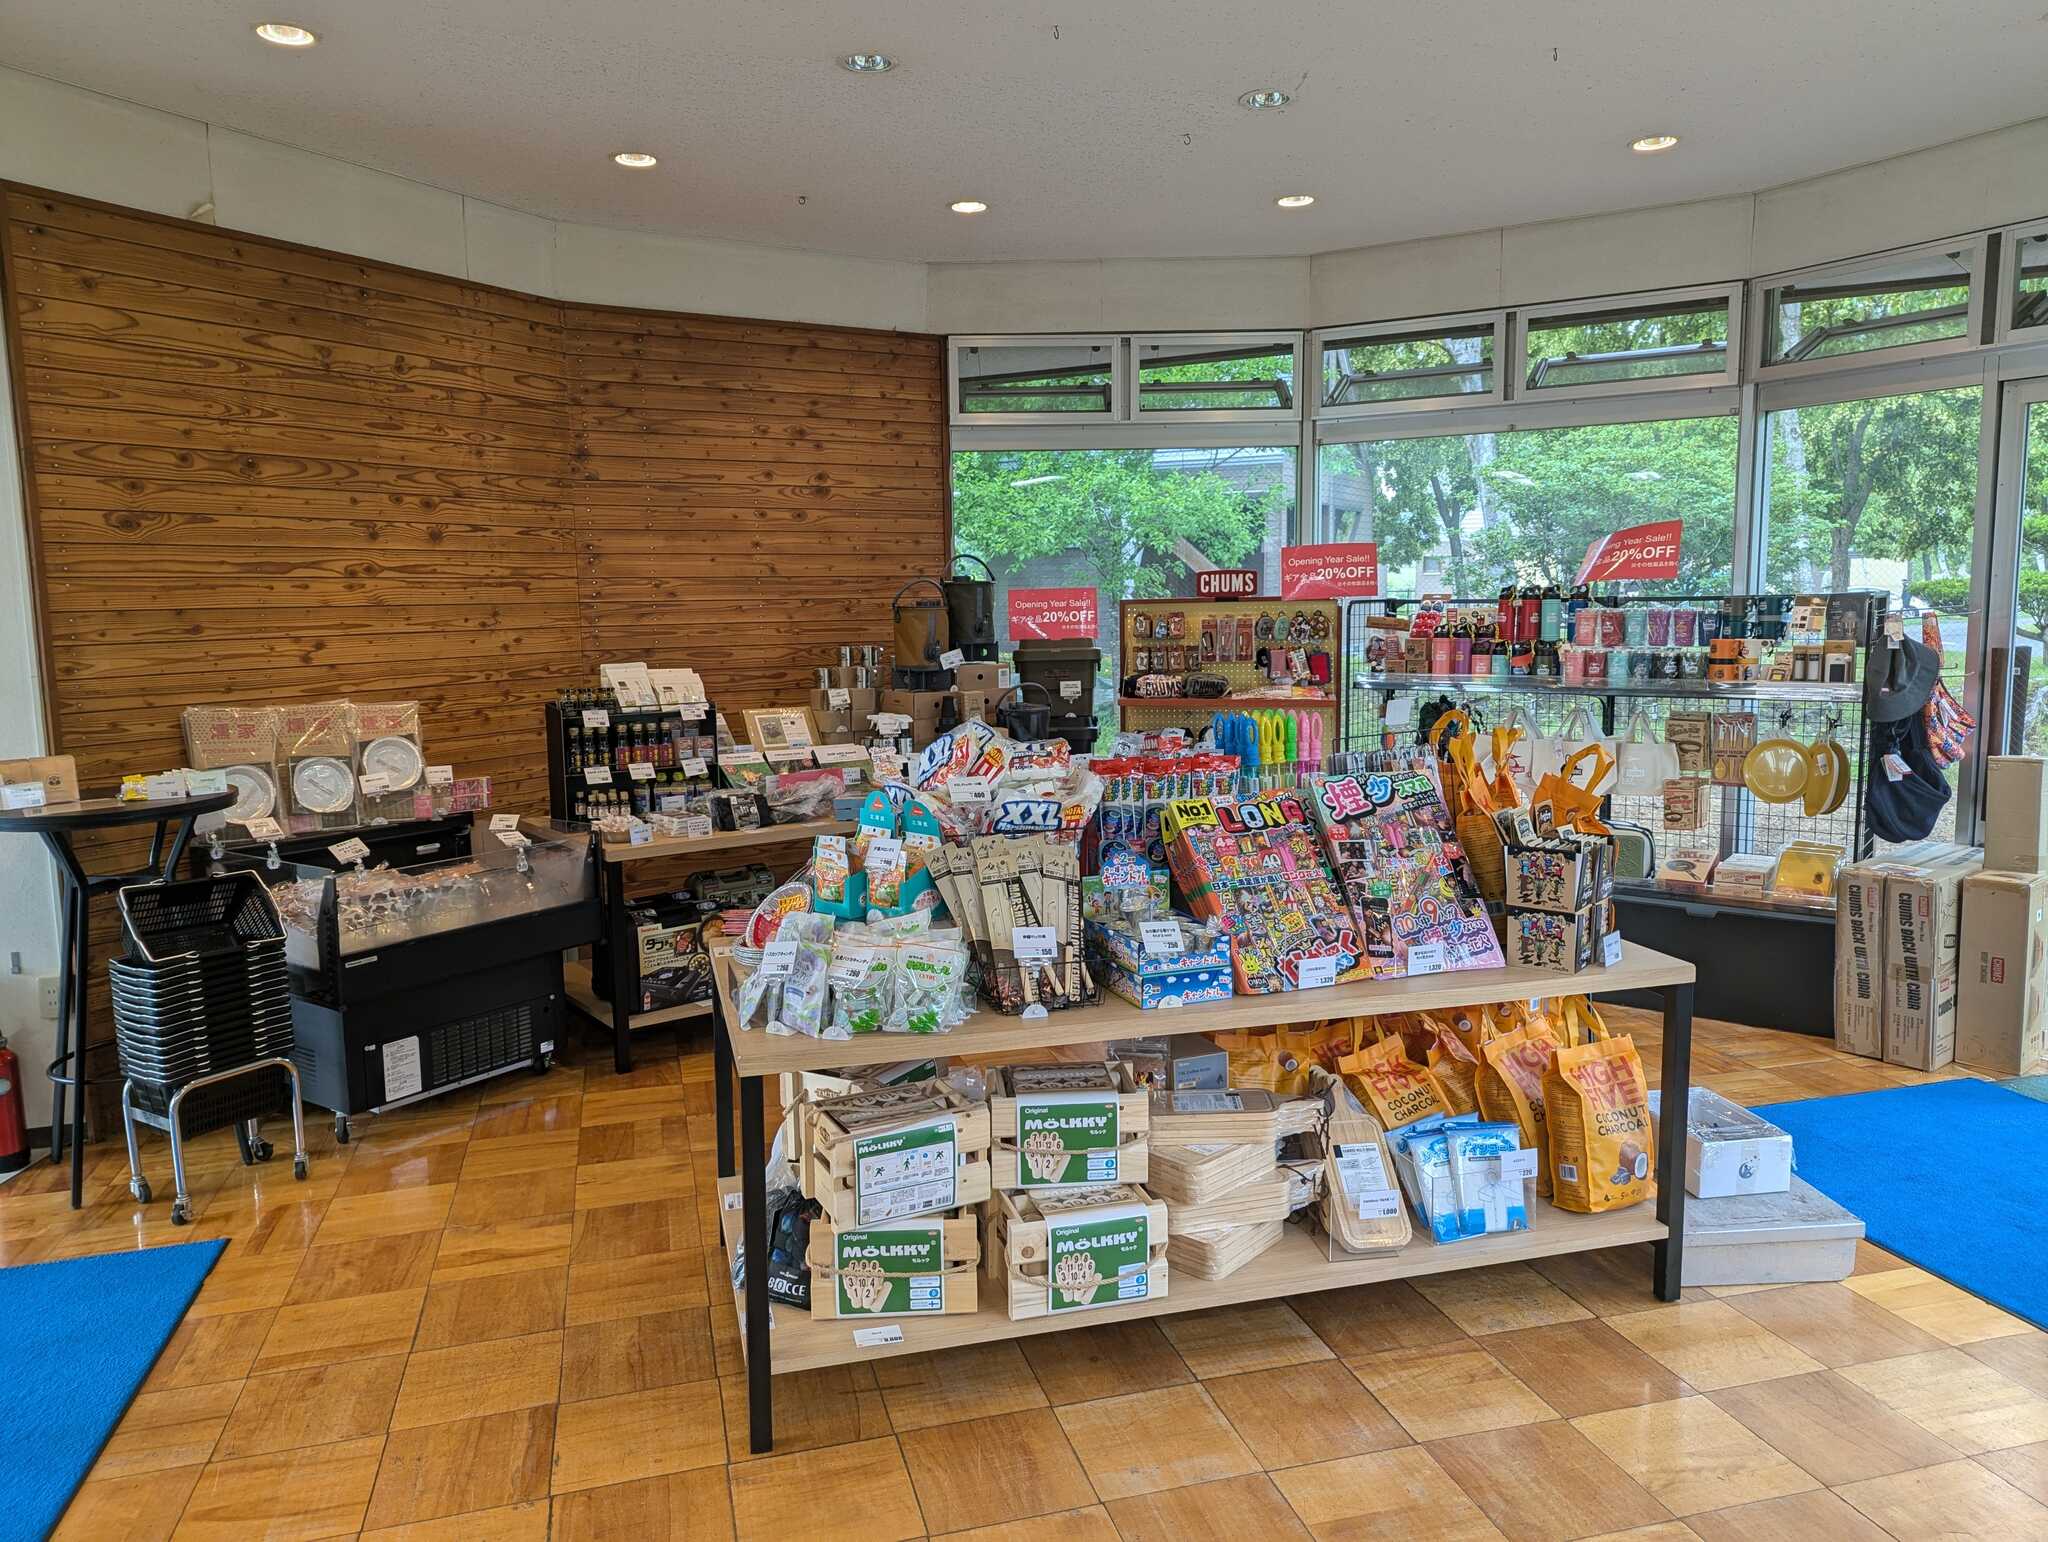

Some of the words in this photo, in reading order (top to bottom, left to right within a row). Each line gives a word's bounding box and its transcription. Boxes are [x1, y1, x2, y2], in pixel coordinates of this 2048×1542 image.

[1624, 537, 1642, 546] Year
[1288, 558, 1322, 567] Opening
[1324, 555, 1344, 564] Year
[1345, 554, 1370, 563] Sale!!
[1199, 573, 1254, 593] CHUMS
[1015, 600, 1048, 609] Opening
[1050, 599, 1067, 607] Year
[1145, 680, 1183, 696] CHUMS
[1393, 776, 1434, 798] スマホ
[1001, 800, 1062, 825] XXL
[1216, 800, 1305, 832] LONG
[1848, 884, 1862, 919] CHUMS
[1898, 892, 1914, 927] CHUMS
[1851, 920, 1866, 945] BACK
[1901, 928, 1917, 954] BACK
[1903, 955, 1919, 982] WITH
[1991, 957, 2004, 984] CHUMS
[1856, 972, 1871, 1000] CHAIR
[1906, 982, 1922, 1011] CHAIR
[1569, 1055, 1634, 1085] HIGH
[1584, 1078, 1641, 1111] FIVE
[1024, 1107, 1049, 1115] Original
[1596, 1103, 1646, 1124] COCONUT
[1024, 1116, 1107, 1130] MÖLKKY
[842, 1233, 868, 1242] Original
[1055, 1227, 1080, 1236] Original
[1056, 1231, 1138, 1253] MÖLKKY
[842, 1244, 930, 1258] MÖLKKY
[768, 1276, 807, 1297] BOCCE
